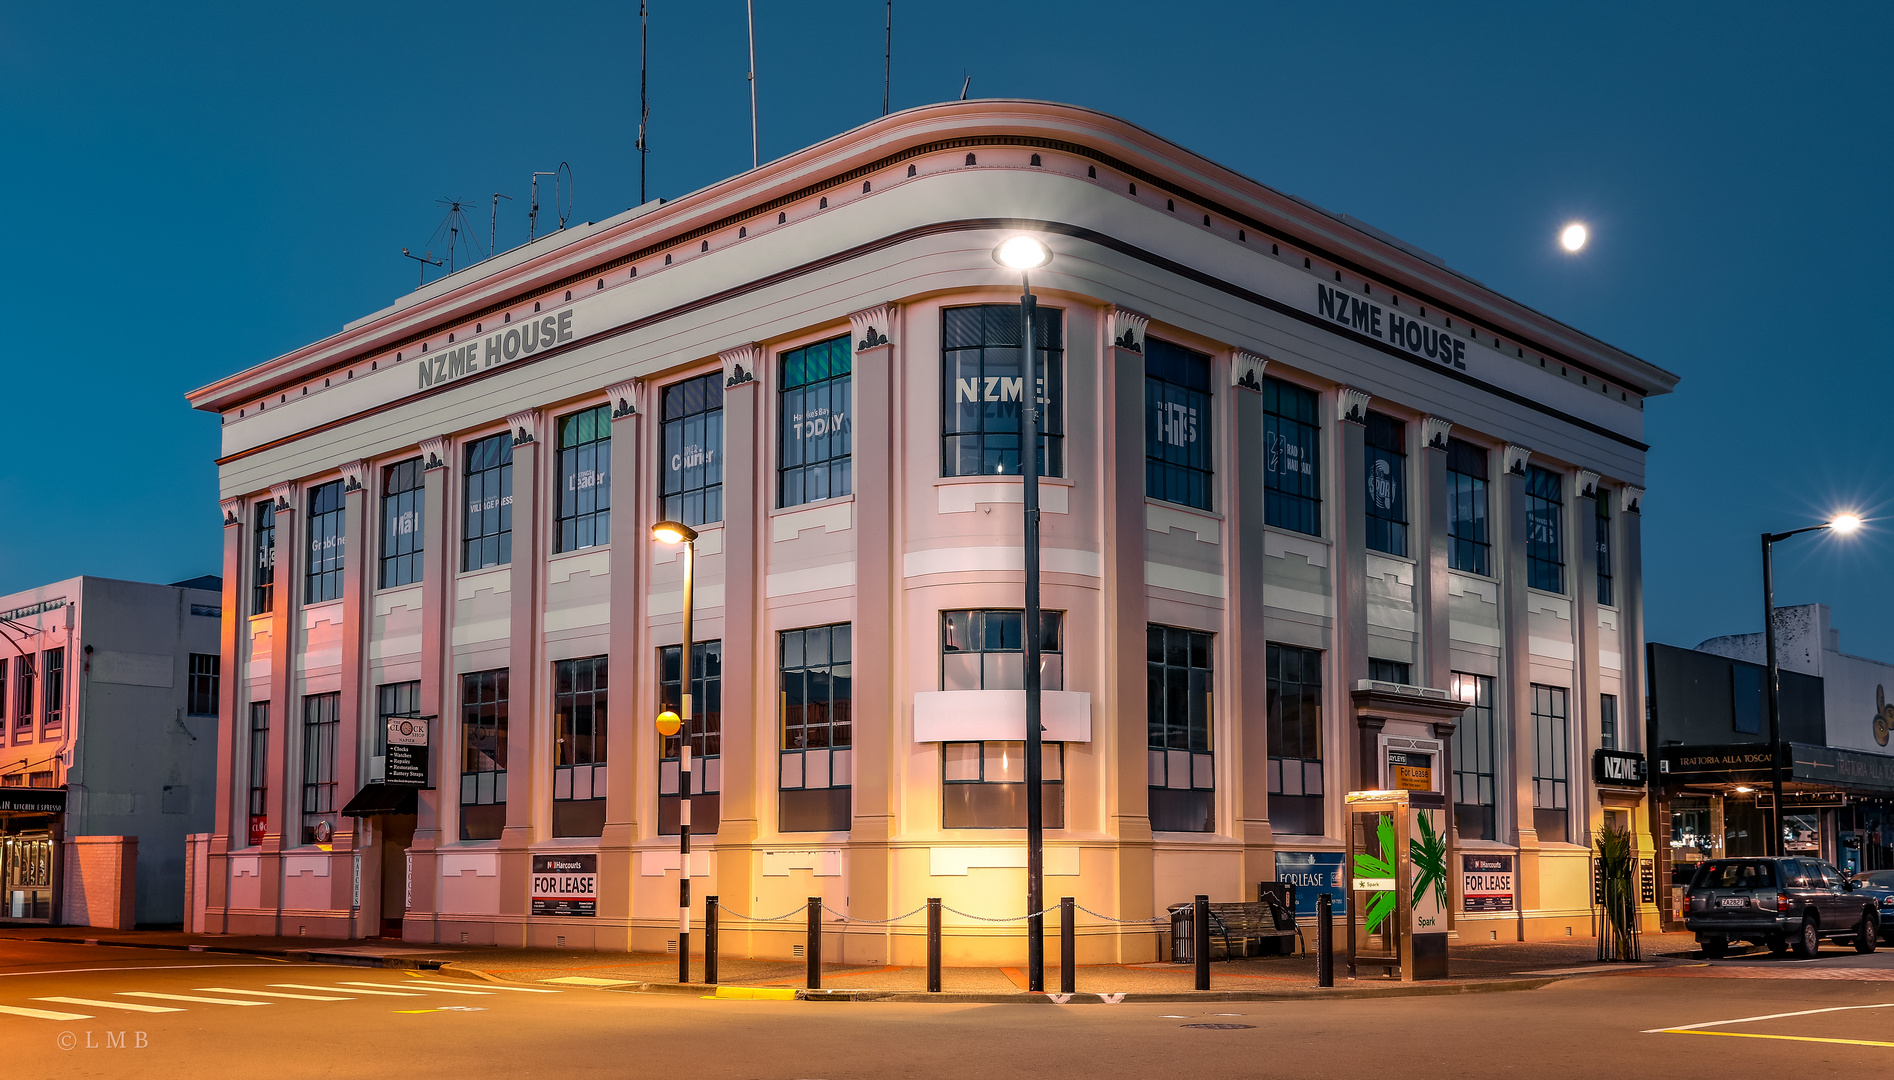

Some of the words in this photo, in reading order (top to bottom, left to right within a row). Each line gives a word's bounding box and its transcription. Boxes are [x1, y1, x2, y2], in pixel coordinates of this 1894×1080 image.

[1318, 282, 1382, 338] NZME
[1389, 312, 1467, 371] HOUSE
[418, 342, 478, 390] NZME
[484, 308, 573, 367] HOUSE
[793, 409, 818, 422] Hake's
[793, 412, 845, 440] TODAY
[1157, 401, 1197, 447] HITS
[1286, 443, 1304, 459] RADO
[1286, 457, 1311, 476] HAUAKI
[1389, 755, 1406, 763] AYLEYS
[1680, 756, 1720, 766] TRATTORIA
[1721, 755, 1742, 764] ALLA
[1743, 753, 1772, 763] TOSCA
[1400, 767, 1410, 777] For
[1411, 768, 1429, 778] Lease
[1604, 756, 1640, 780] NZME.
[13, 803, 35, 811] KITCHEN
[534, 877, 557, 894] FOR
[559, 876, 594, 894] LEASE
[1280, 873, 1298, 887] FOR
[1298, 873, 1324, 887] LEASE
[1465, 875, 1483, 891] FOR
[1484, 875, 1511, 891] LEASE
[1418, 916, 1436, 928] Spark
